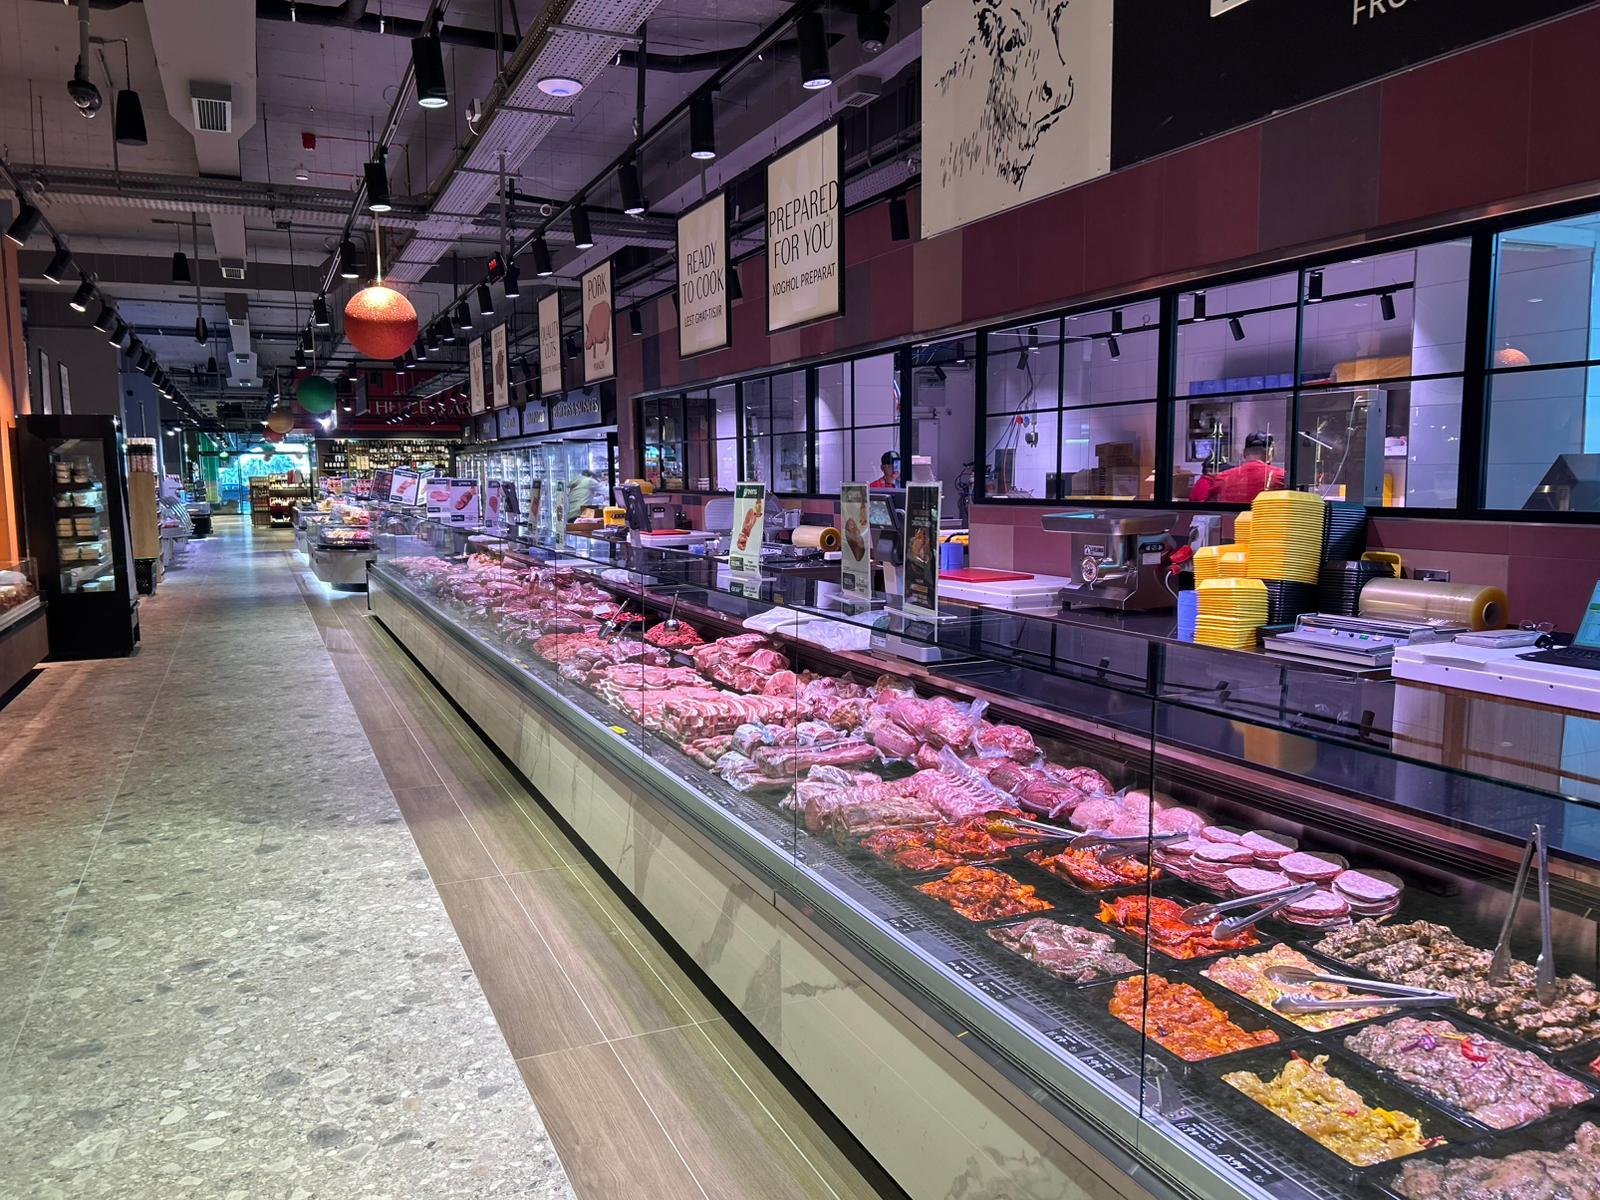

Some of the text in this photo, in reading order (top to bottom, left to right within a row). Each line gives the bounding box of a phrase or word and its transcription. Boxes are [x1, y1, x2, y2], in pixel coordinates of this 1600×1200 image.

[769, 180, 839, 238] PREPARED
[686, 240, 717, 276] READY
[774, 218, 834, 269] FOR YOU
[587, 272, 607, 301] PORK
[682, 267, 724, 305] TO COOK
[800, 262, 836, 287] PREPARAT
[540, 319, 559, 346] QUALITY
